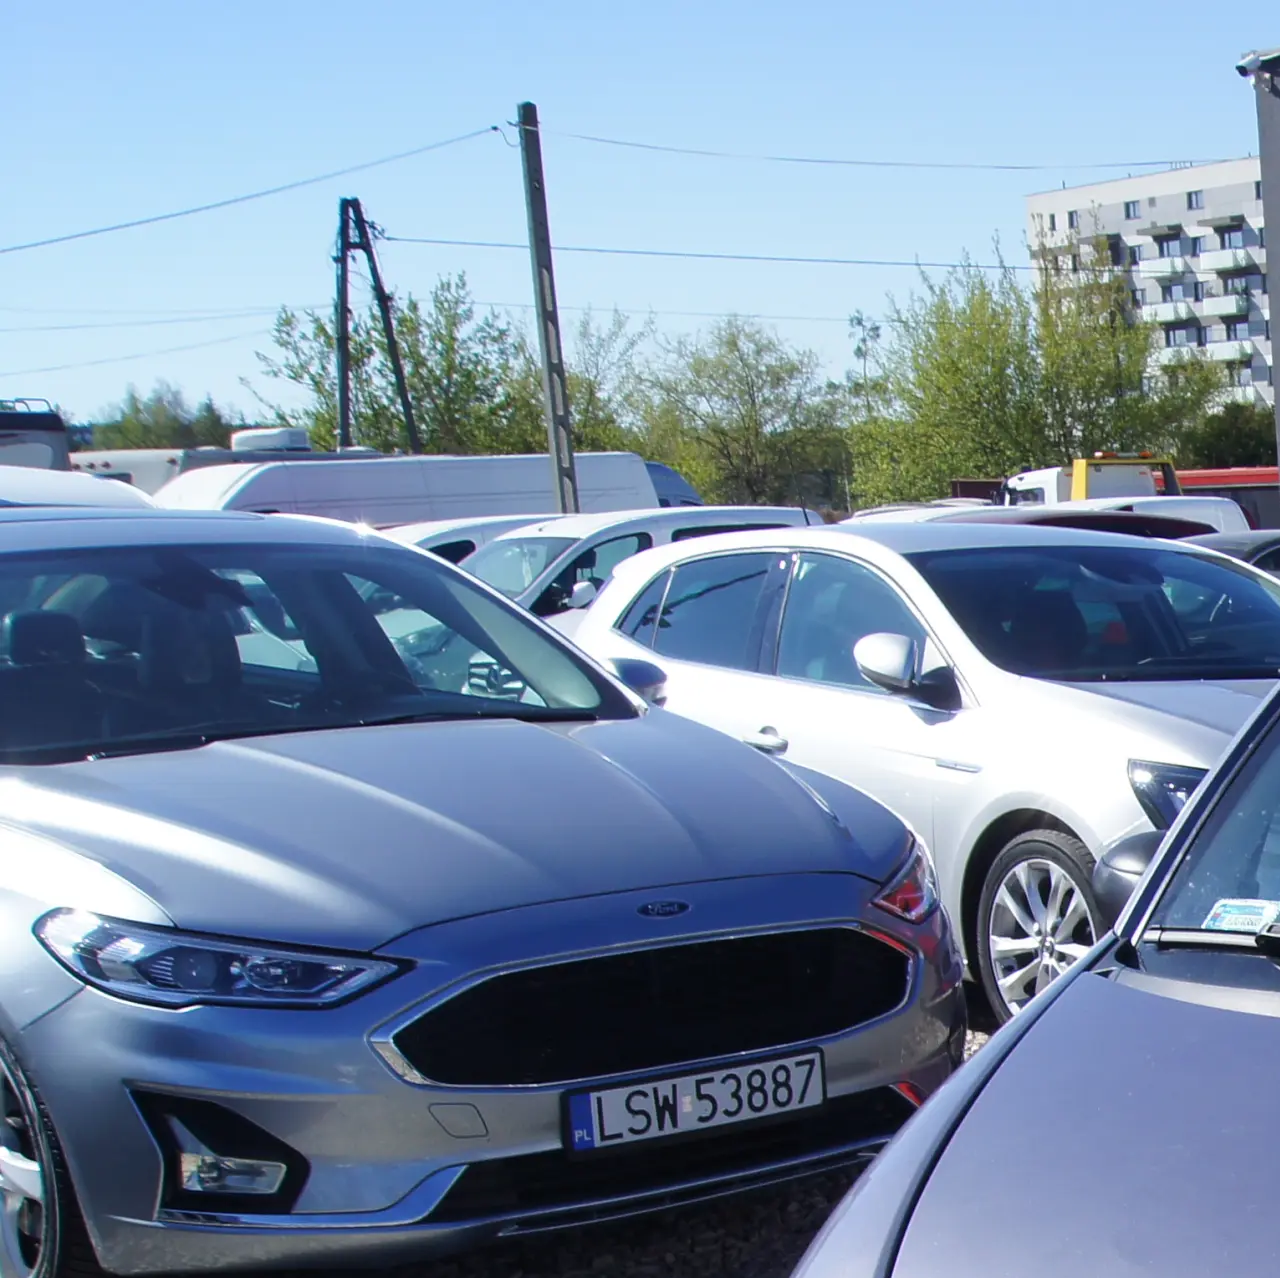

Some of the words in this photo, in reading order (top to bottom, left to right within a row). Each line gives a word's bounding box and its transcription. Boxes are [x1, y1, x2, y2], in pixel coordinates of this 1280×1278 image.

[596, 1084, 678, 1142] LSW
[695, 1058, 815, 1123] 53887
[574, 1129, 591, 1143] PL
